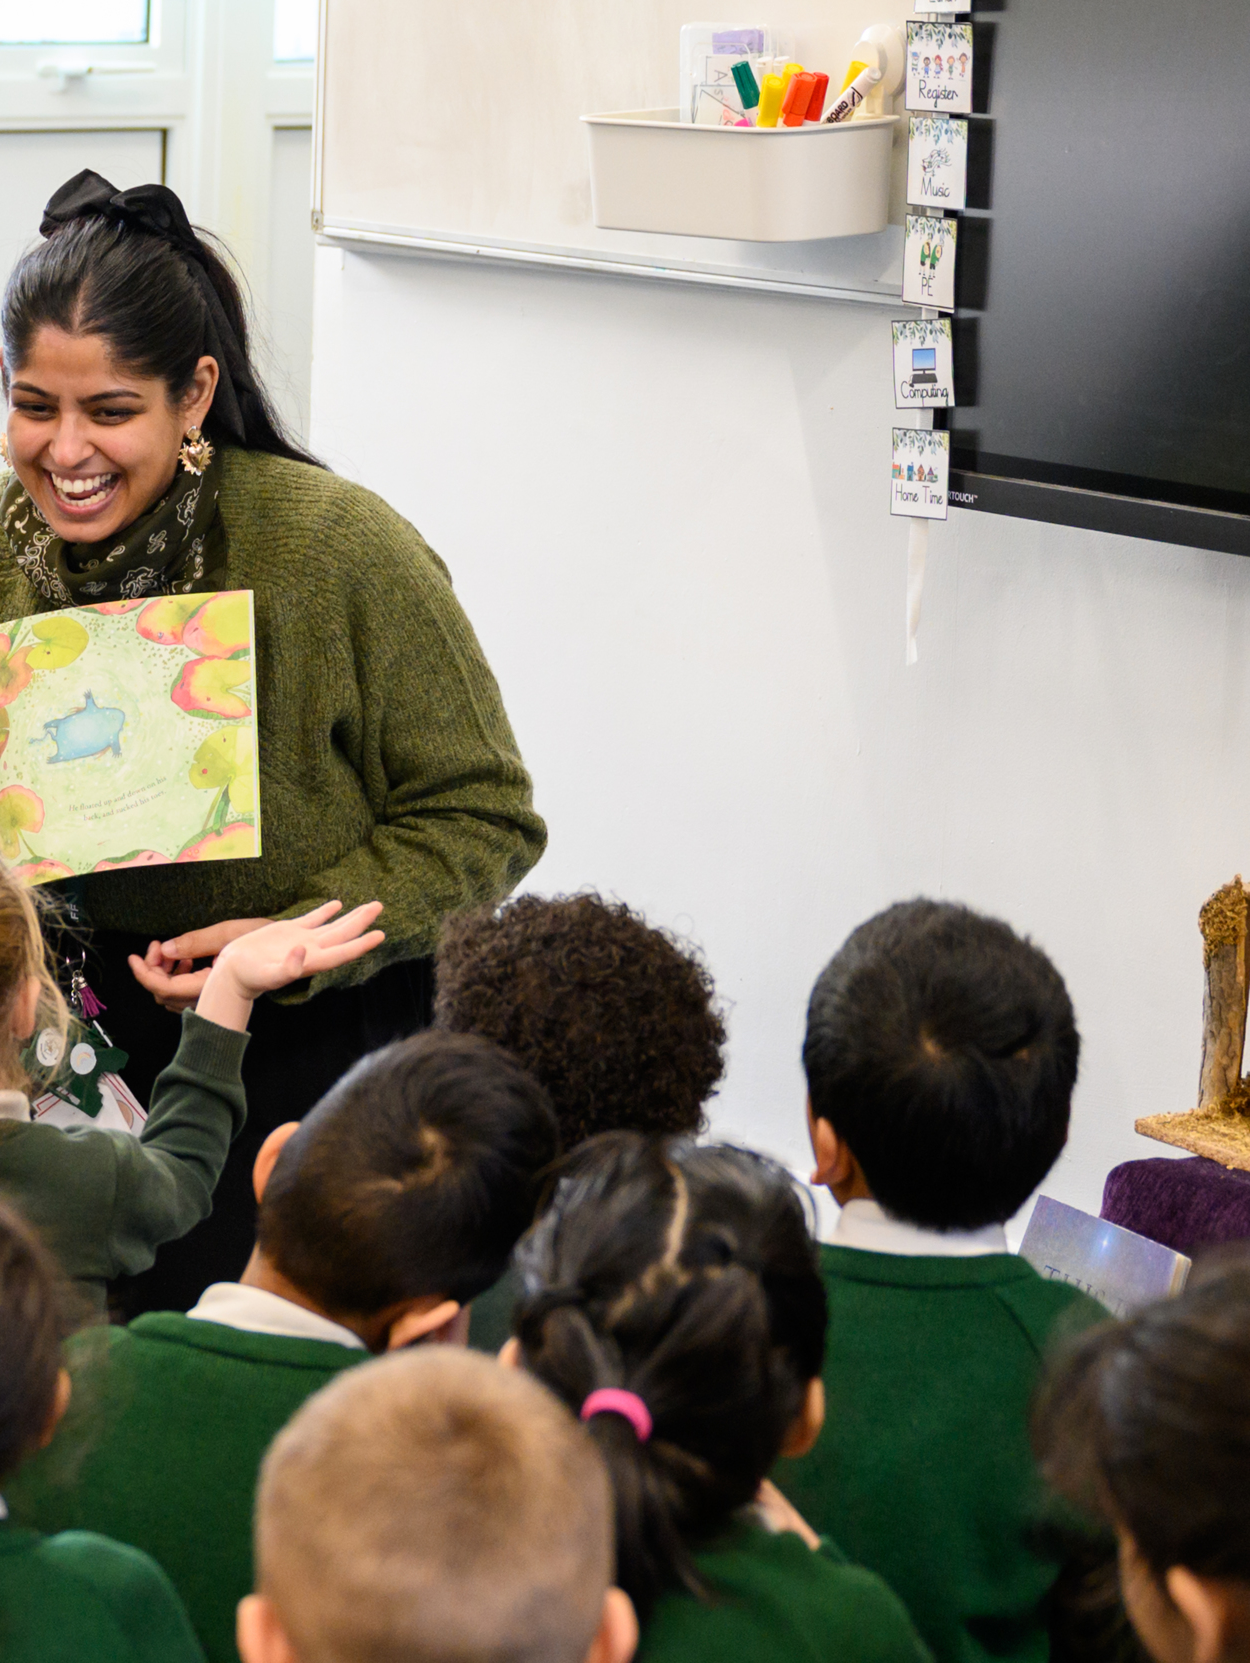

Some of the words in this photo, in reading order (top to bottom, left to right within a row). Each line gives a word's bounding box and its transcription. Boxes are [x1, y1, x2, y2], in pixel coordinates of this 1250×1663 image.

[918, 79, 958, 108] Register
[920, 177, 950, 198] Music
[922, 276, 933, 296] PE
[900, 381, 949, 407] Computing
[895, 483, 919, 502] Home
[922, 485, 943, 505] Time
[68, 804, 78, 812] He
[114, 793, 126, 803] and
[156, 776, 167, 786] his
[102, 809, 114, 818] and
